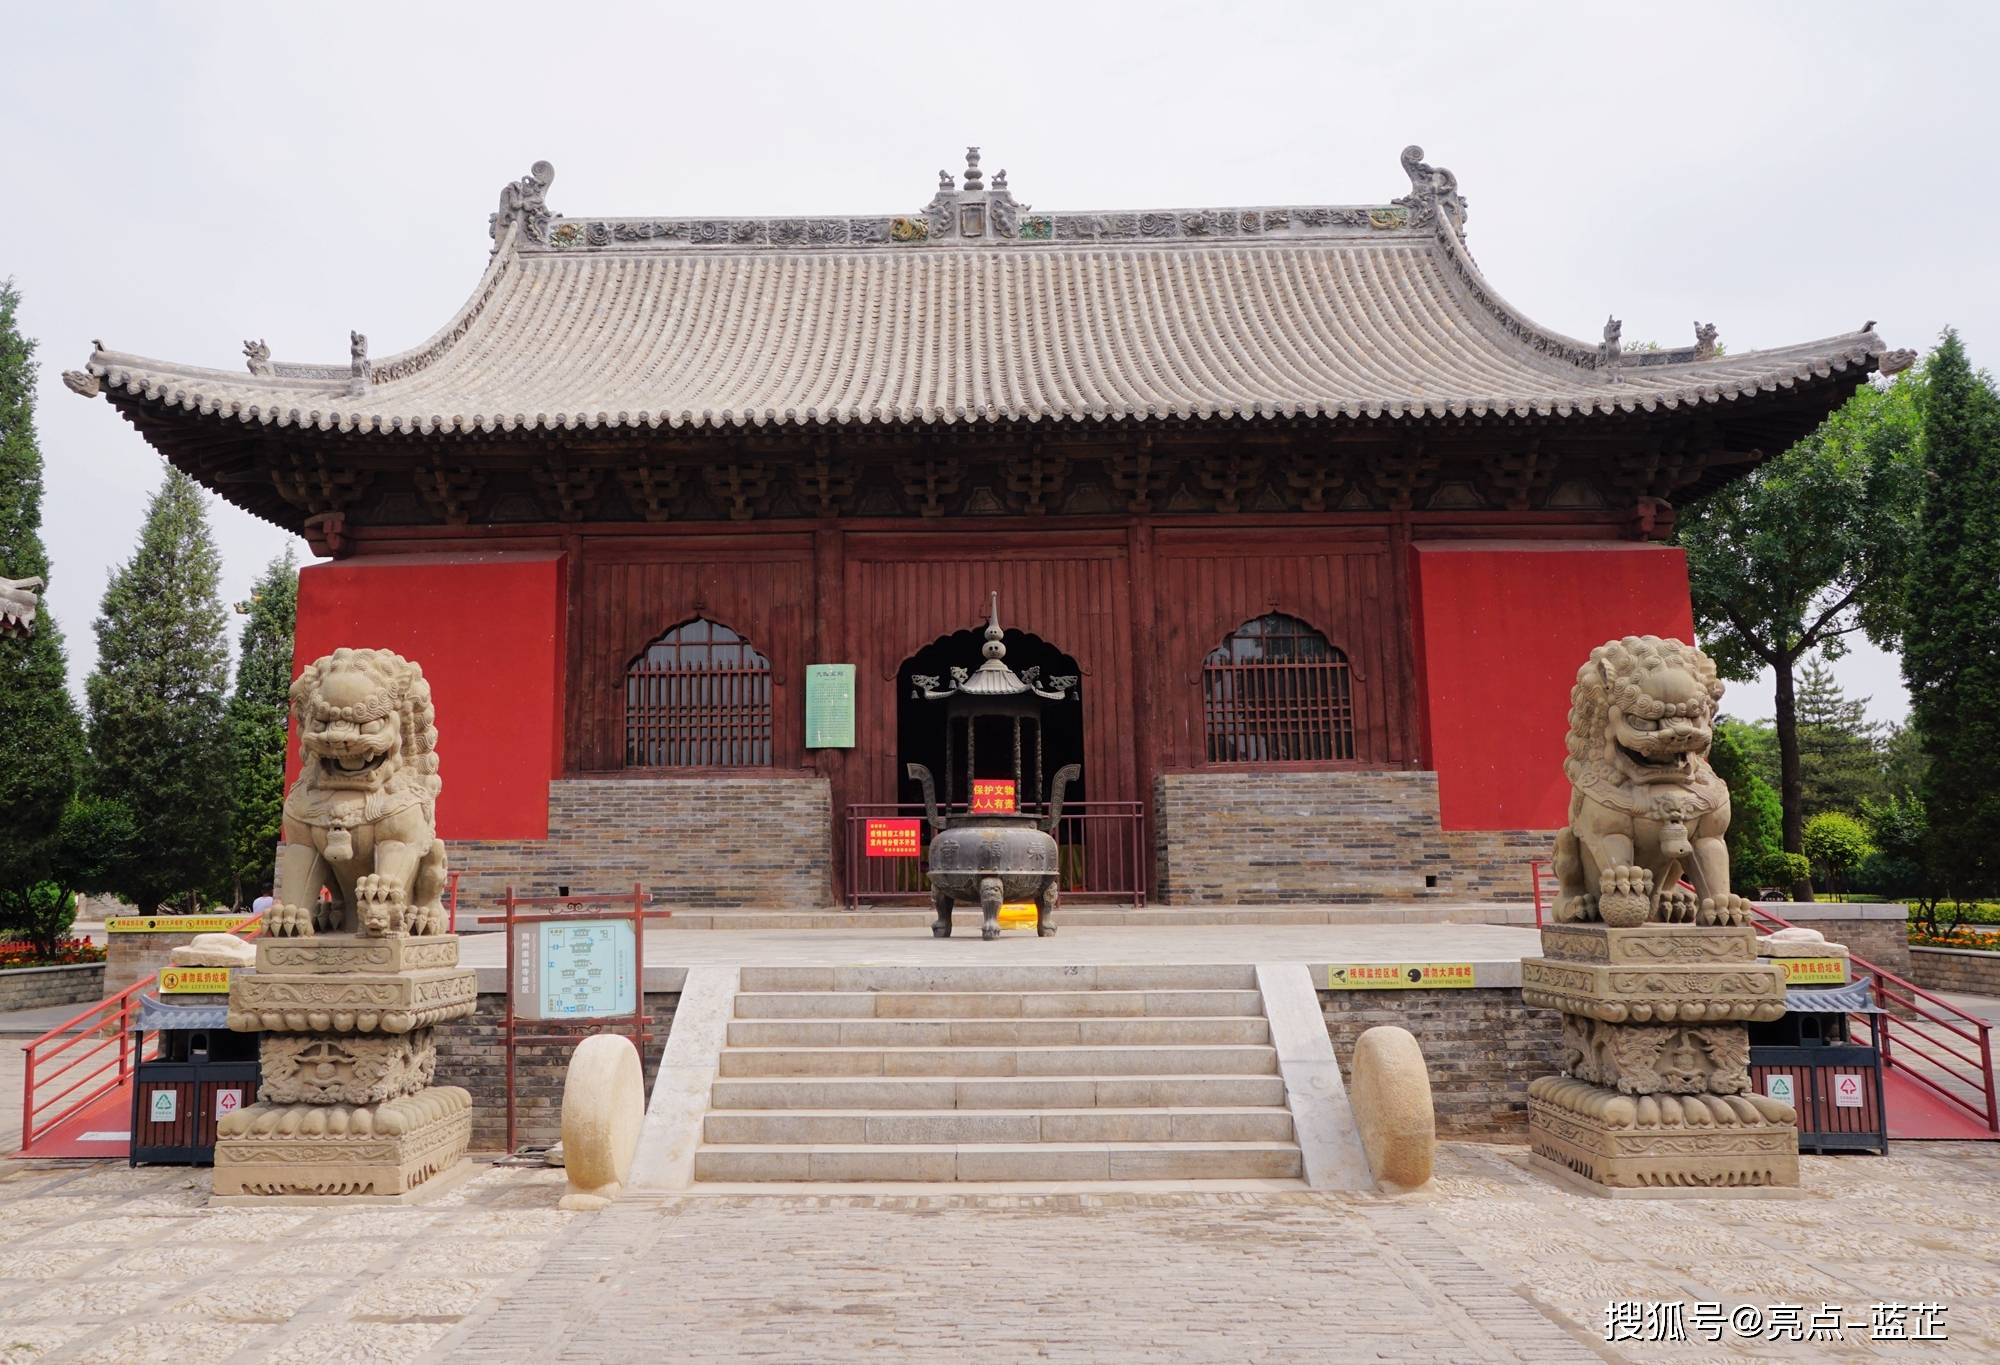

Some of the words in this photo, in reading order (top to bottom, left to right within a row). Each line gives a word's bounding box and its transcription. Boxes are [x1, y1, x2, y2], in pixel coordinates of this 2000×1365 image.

[974, 784, 1015, 795] 保护文物
[974, 798, 1014, 809] 人人有责
[1350, 967, 1399, 978] 视频监控区域
[1422, 966, 1471, 978] 请勿大声喧哗
[1792, 962, 1841, 974] 请勿乱扔垃圾
[180, 972, 227, 983] 请勿乱扔垃圾
